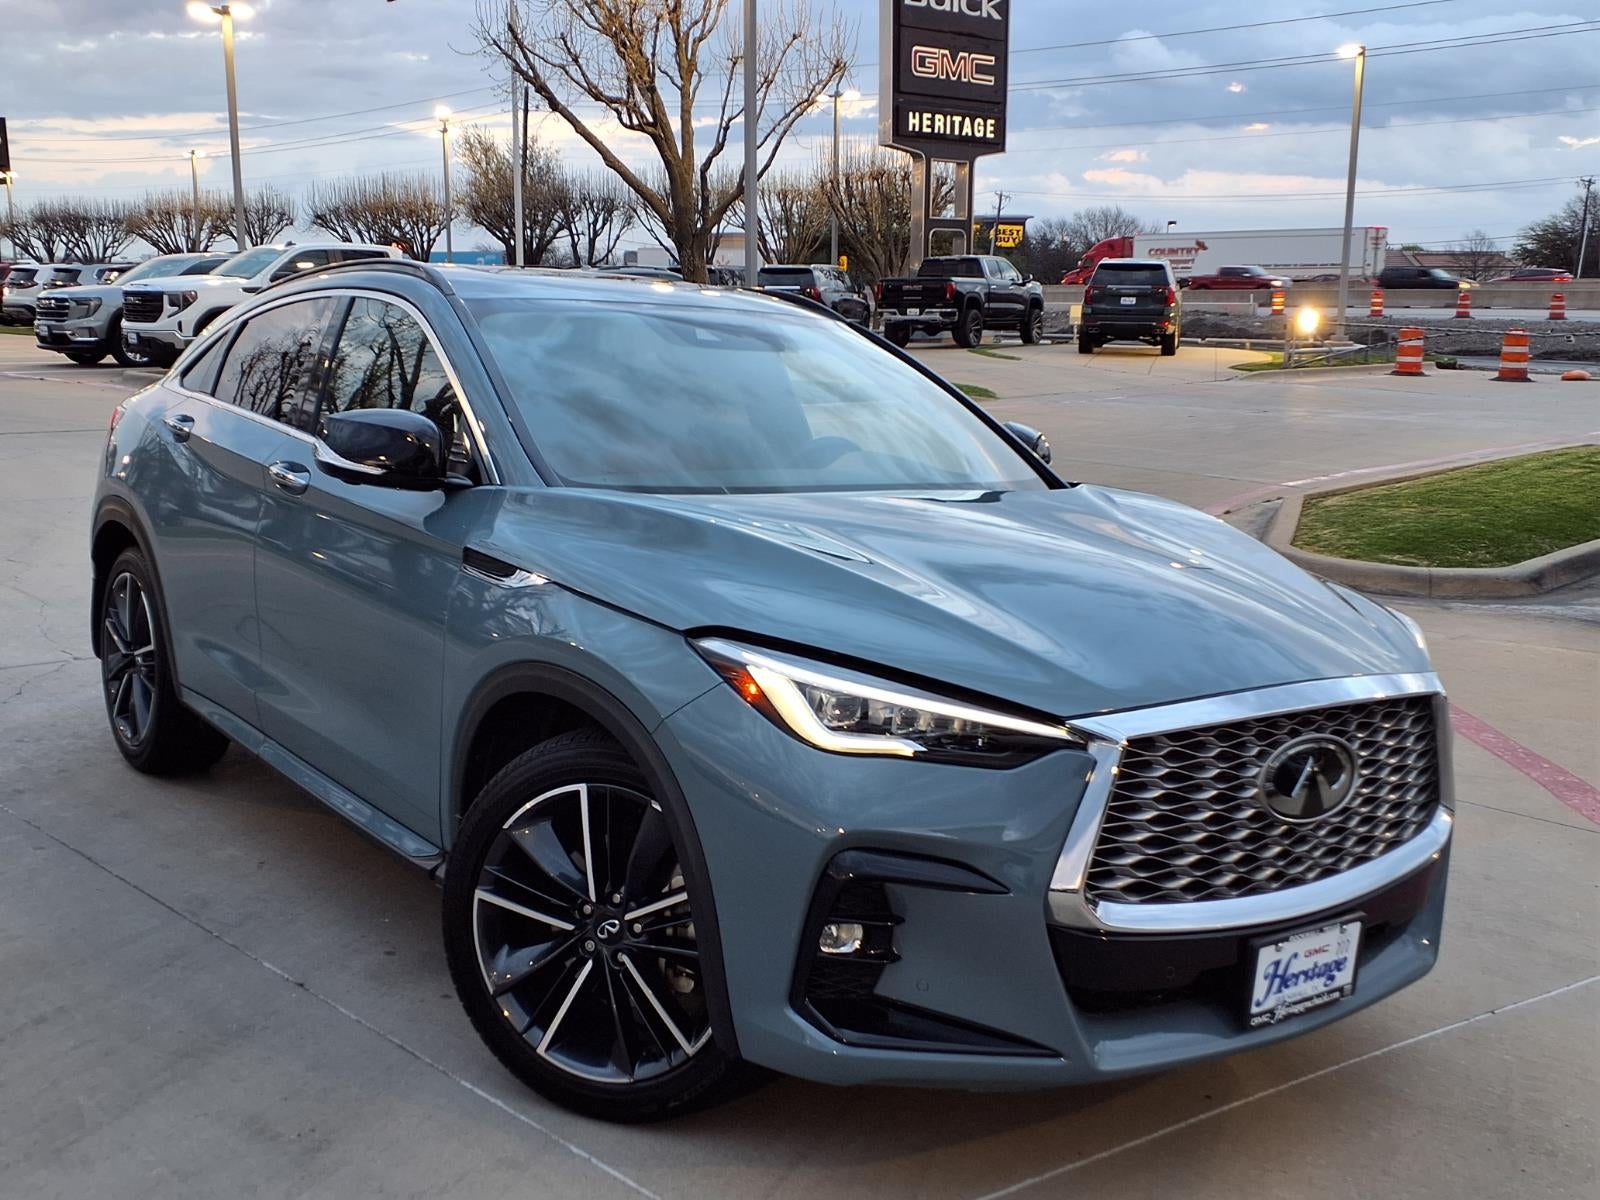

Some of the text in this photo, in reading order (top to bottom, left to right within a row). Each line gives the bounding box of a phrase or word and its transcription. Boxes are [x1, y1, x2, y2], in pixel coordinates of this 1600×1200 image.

[904, 0, 1003, 20] uick
[911, 45, 995, 86] GMC
[908, 111, 995, 139] HERITAGE
[1148, 247, 1200, 257] COUNTRY
[1304, 944, 1330, 958] GMC
[1255, 951, 1348, 1008] Heritage
